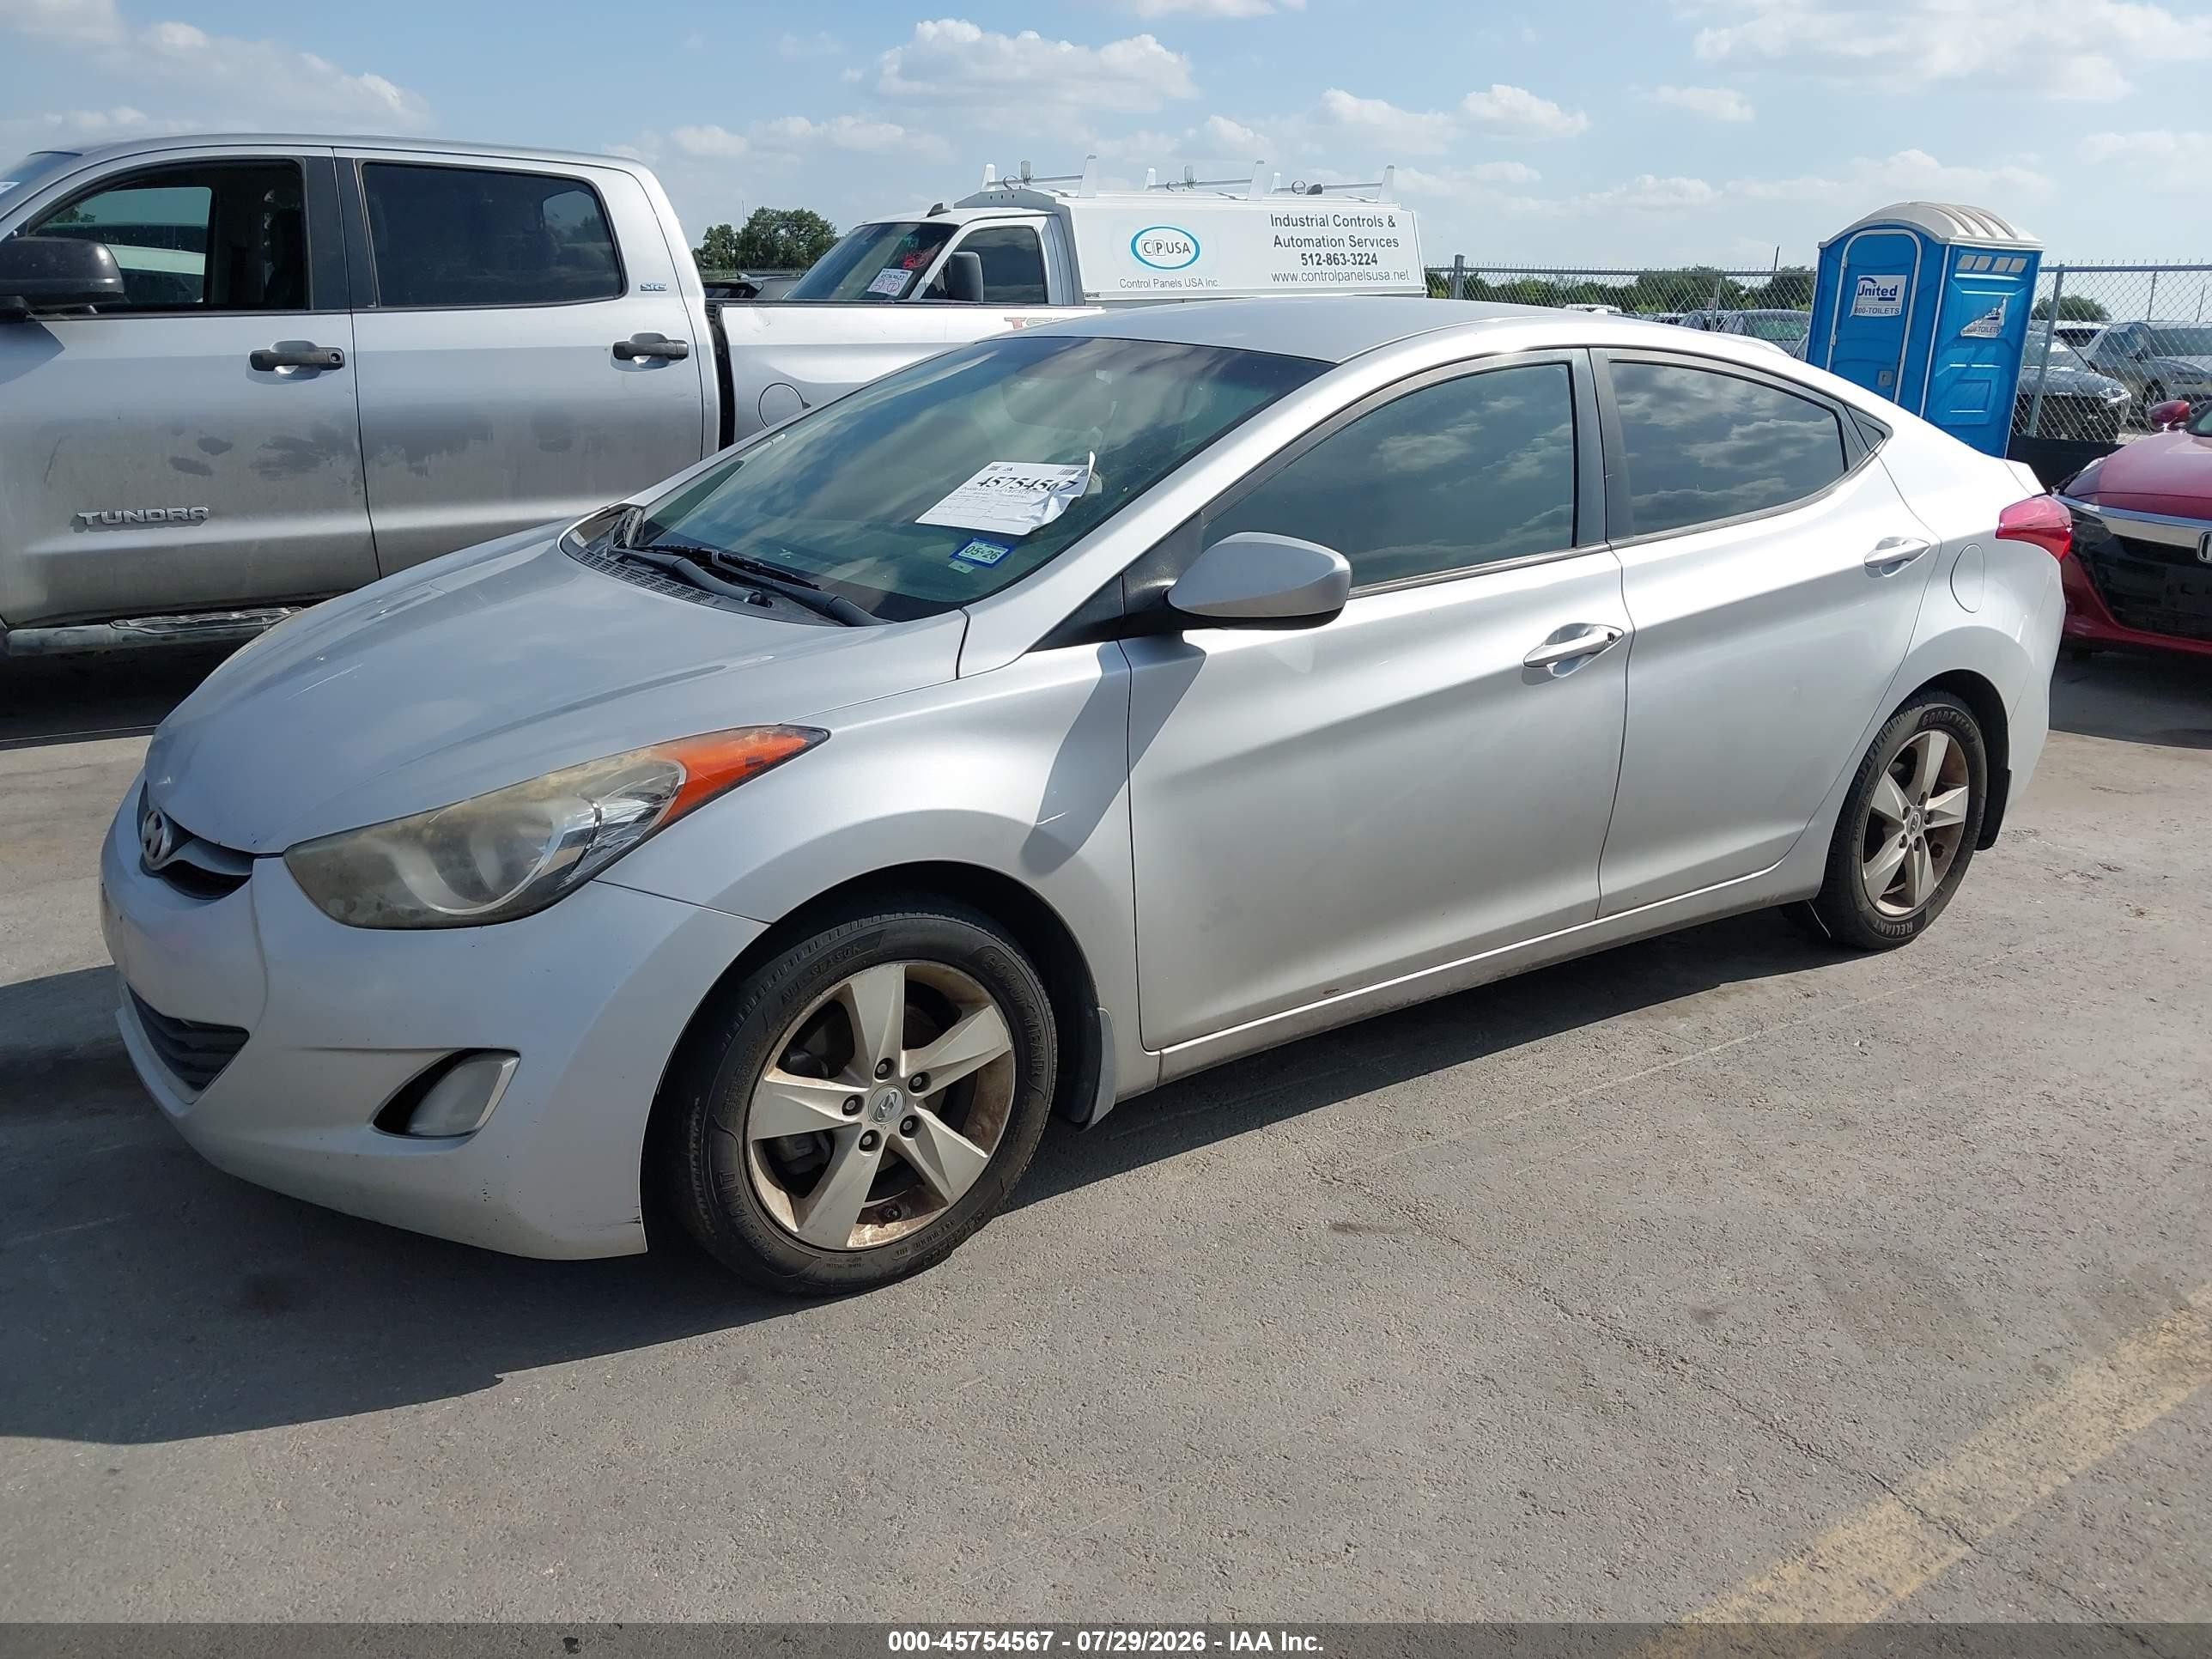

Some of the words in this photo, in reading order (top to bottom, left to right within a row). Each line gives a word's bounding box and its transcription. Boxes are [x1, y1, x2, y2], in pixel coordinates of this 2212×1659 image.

[1270, 213, 1329, 228] Industrial
[1332, 213, 1385, 228] Controls
[1387, 214, 1396, 228] &
[1273, 234, 1346, 248] Automation
[1348, 234, 1400, 248] Services
[1301, 252, 1377, 266] 512-863-3224
[1120, 277, 1151, 289] Control
[1153, 277, 1182, 289] Panels
[1184, 277, 1203, 288] USA
[1205, 277, 1220, 288] Inc.
[1271, 269, 1410, 284] www.controlpanelsusa.net
[1857, 285, 1897, 296] United
[76, 507, 209, 526] TUNDRA
[1875, 920, 1913, 935] RELIANT
[983, 953, 1045, 1077] GOODYEAR
